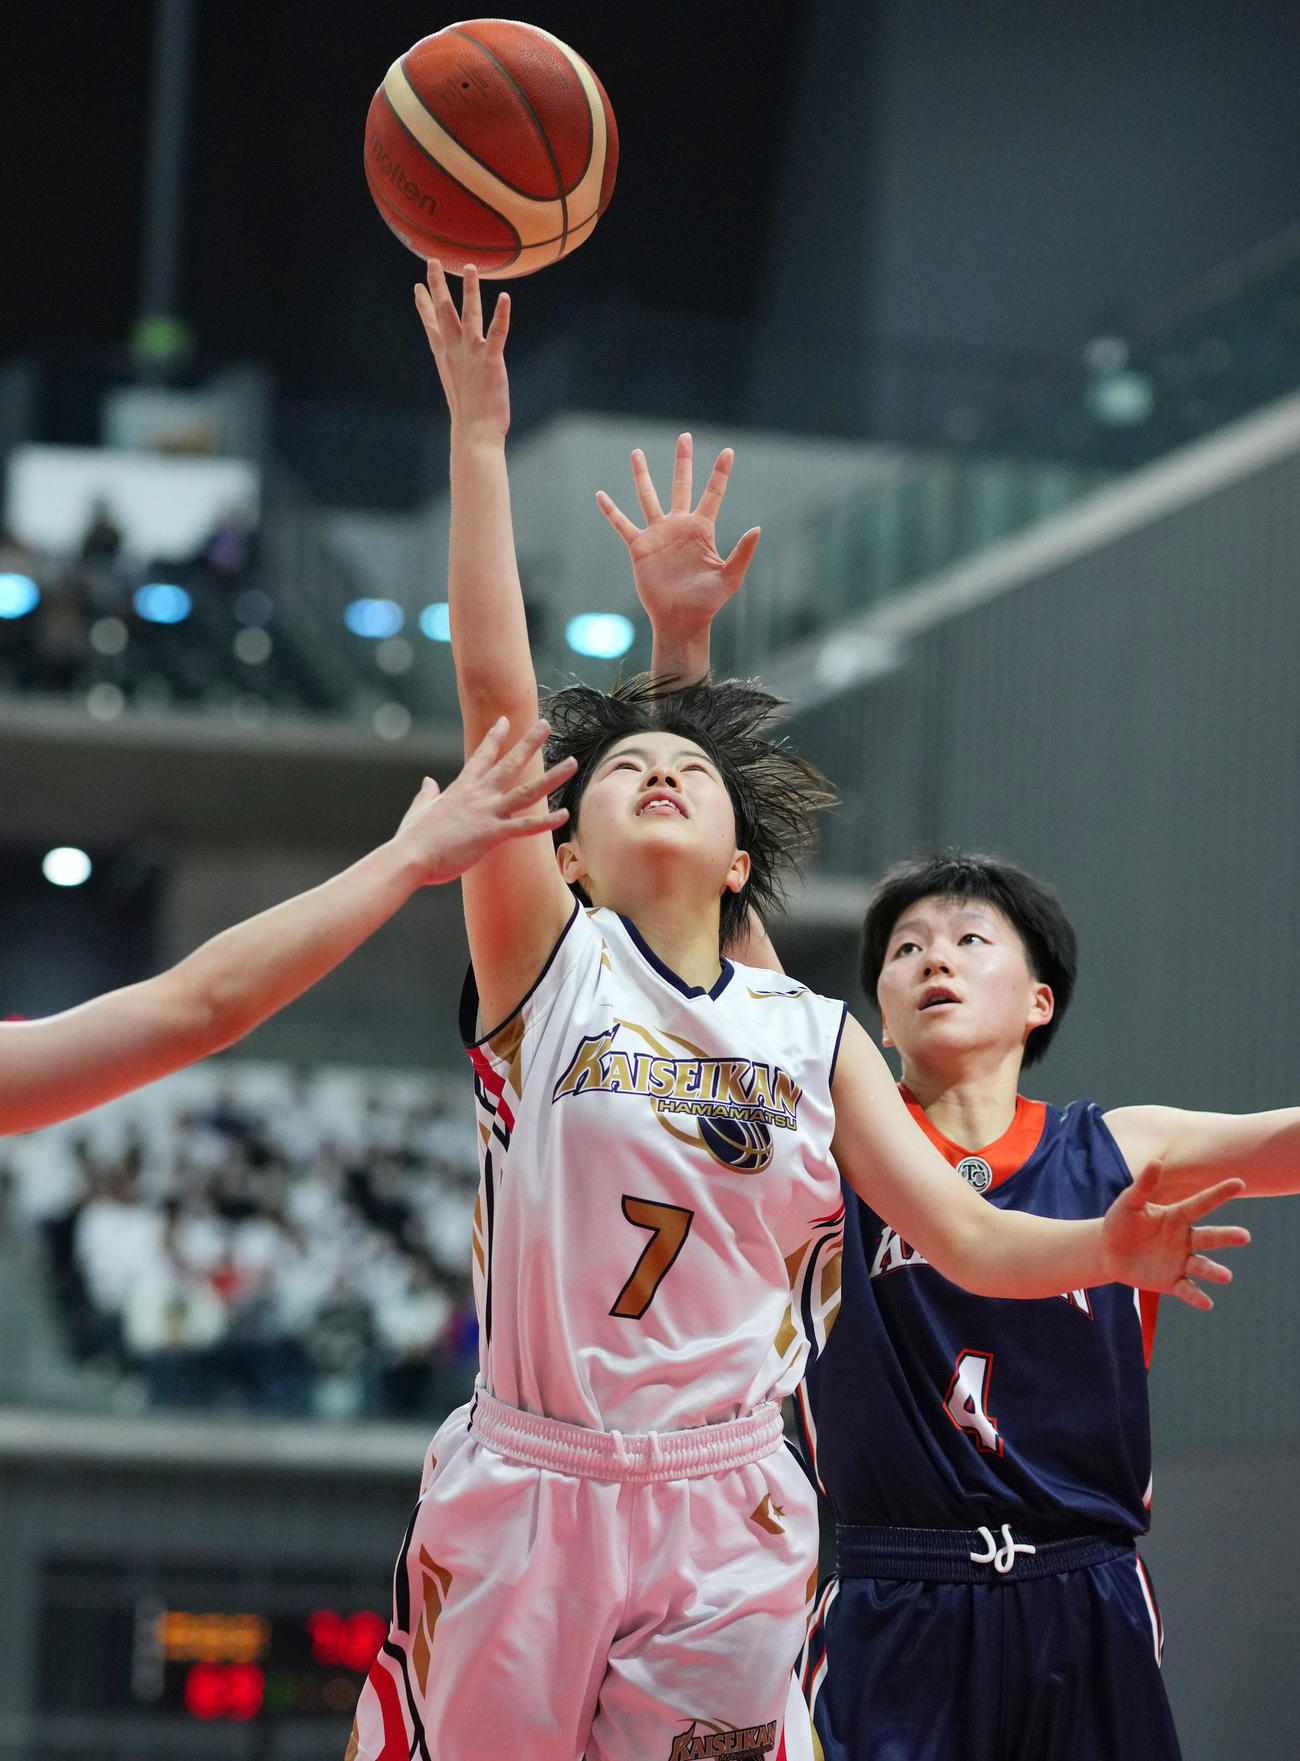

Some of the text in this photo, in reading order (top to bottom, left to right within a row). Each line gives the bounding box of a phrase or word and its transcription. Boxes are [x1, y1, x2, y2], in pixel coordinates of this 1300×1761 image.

[370, 131, 438, 216] molten
[552, 1023, 802, 1117] KAISEIKAN
[657, 1099, 798, 1131] HAMAMATSU
[608, 1194, 695, 1320] 7
[943, 1348, 1004, 1458] 4
[669, 1720, 777, 1761] KAISEIKAN
